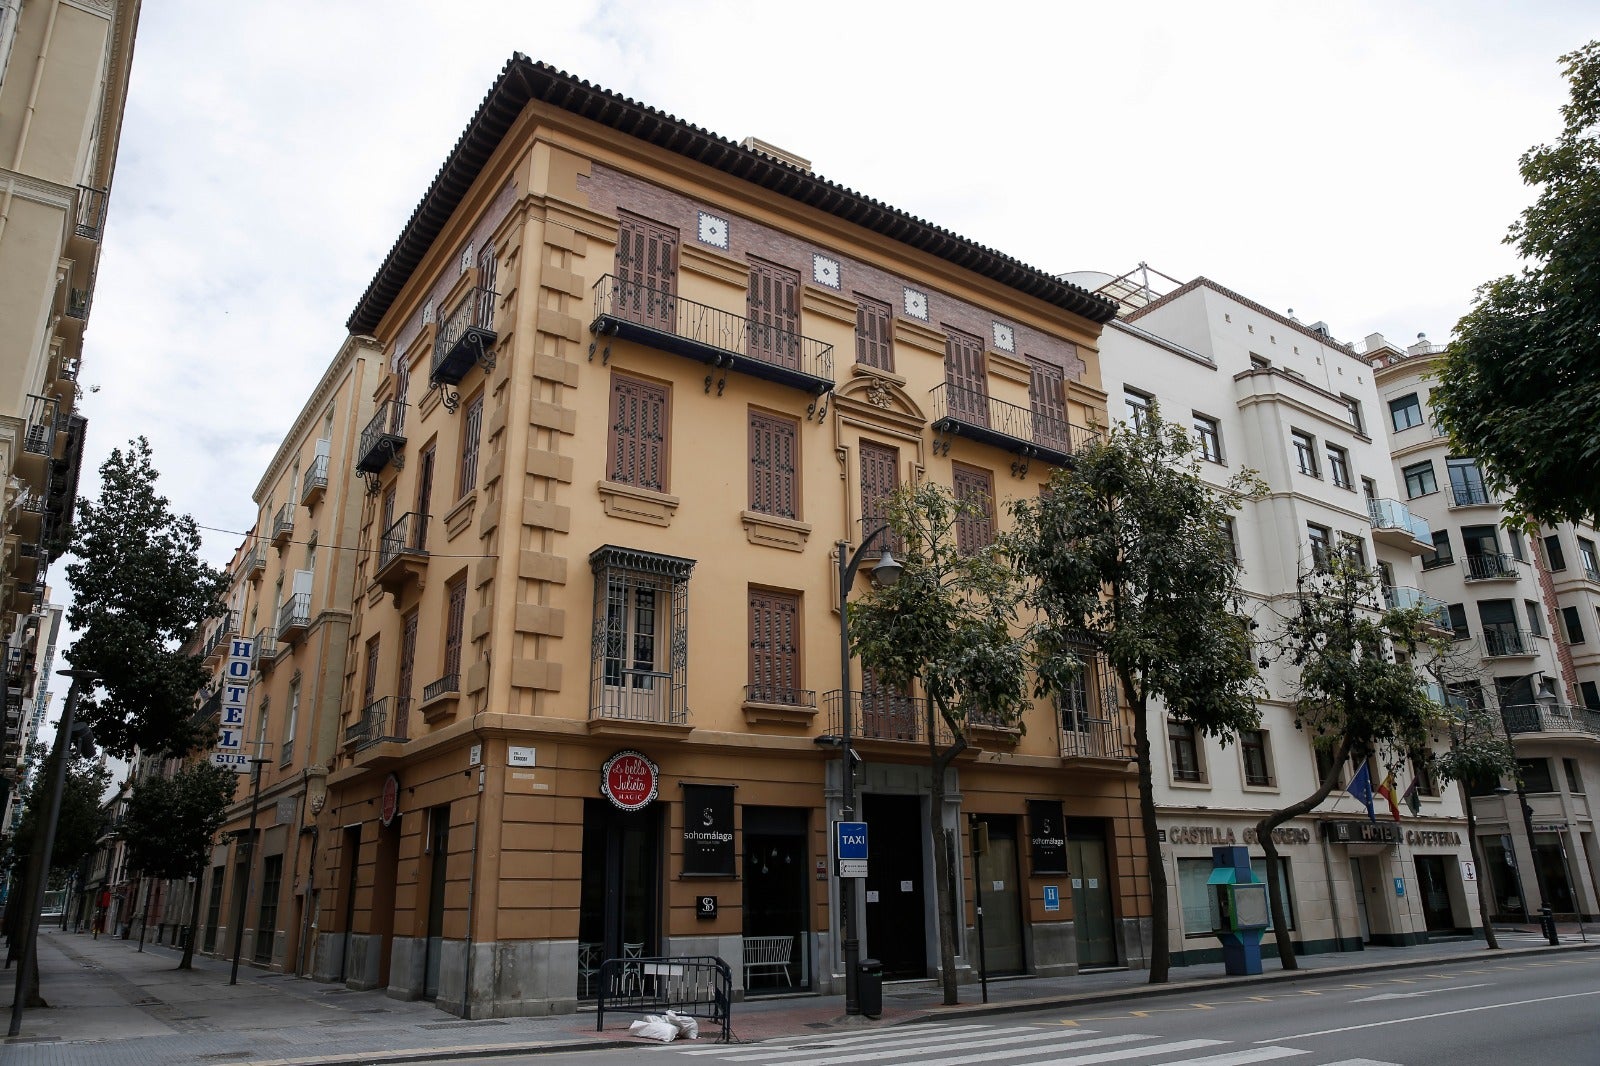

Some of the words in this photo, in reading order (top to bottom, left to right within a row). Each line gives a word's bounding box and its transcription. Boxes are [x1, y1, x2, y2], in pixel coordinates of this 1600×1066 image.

[221, 641, 252, 747] HOTEL
[216, 754, 247, 765] SUR
[624, 759, 647, 775] bella
[613, 774, 646, 791] Julieta
[618, 793, 643, 801] MAGIC
[684, 830, 733, 842] sohomálaga
[841, 835, 865, 845] TAXI
[1170, 826, 1236, 844] CASTILLA
[1243, 826, 1310, 845] GRRERO
[1360, 824, 1396, 840] HOTE
[1406, 829, 1462, 847] CAFETERIA
[1032, 837, 1064, 847] sohomálaga
